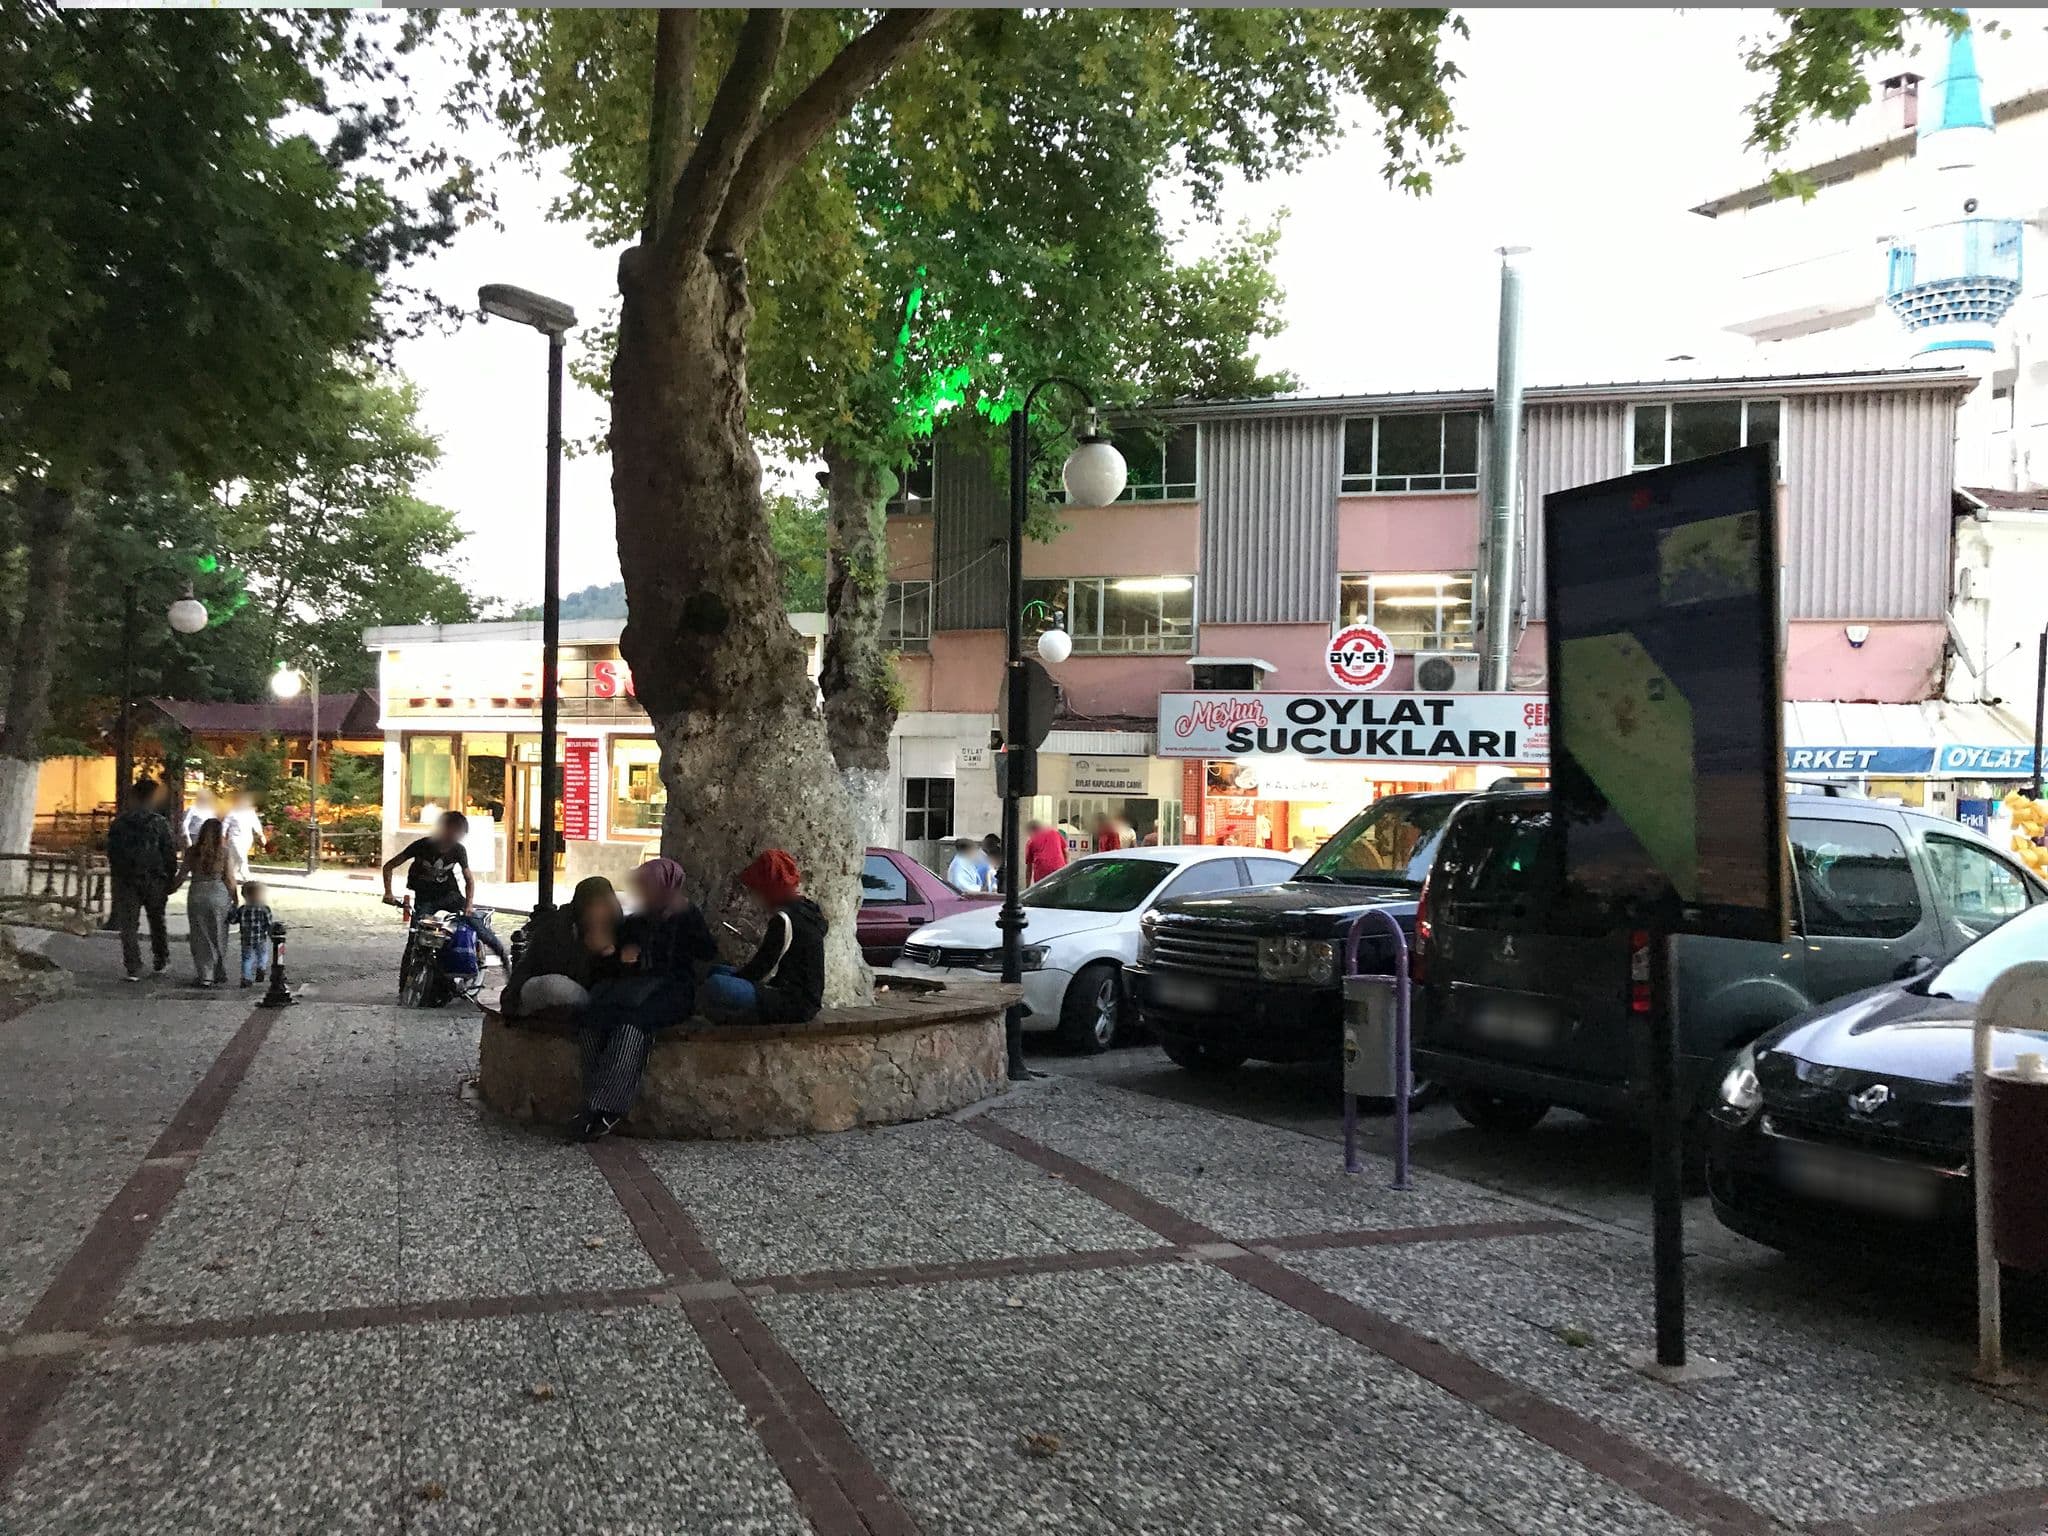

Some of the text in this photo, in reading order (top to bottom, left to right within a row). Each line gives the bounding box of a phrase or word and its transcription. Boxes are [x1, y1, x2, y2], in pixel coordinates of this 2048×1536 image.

[1175, 697, 1268, 737] Meşhur
[1286, 698, 1454, 726] OYLAT
[1225, 727, 1516, 757] SUCUKLARI
[1947, 748, 2029, 769] OYLAT
